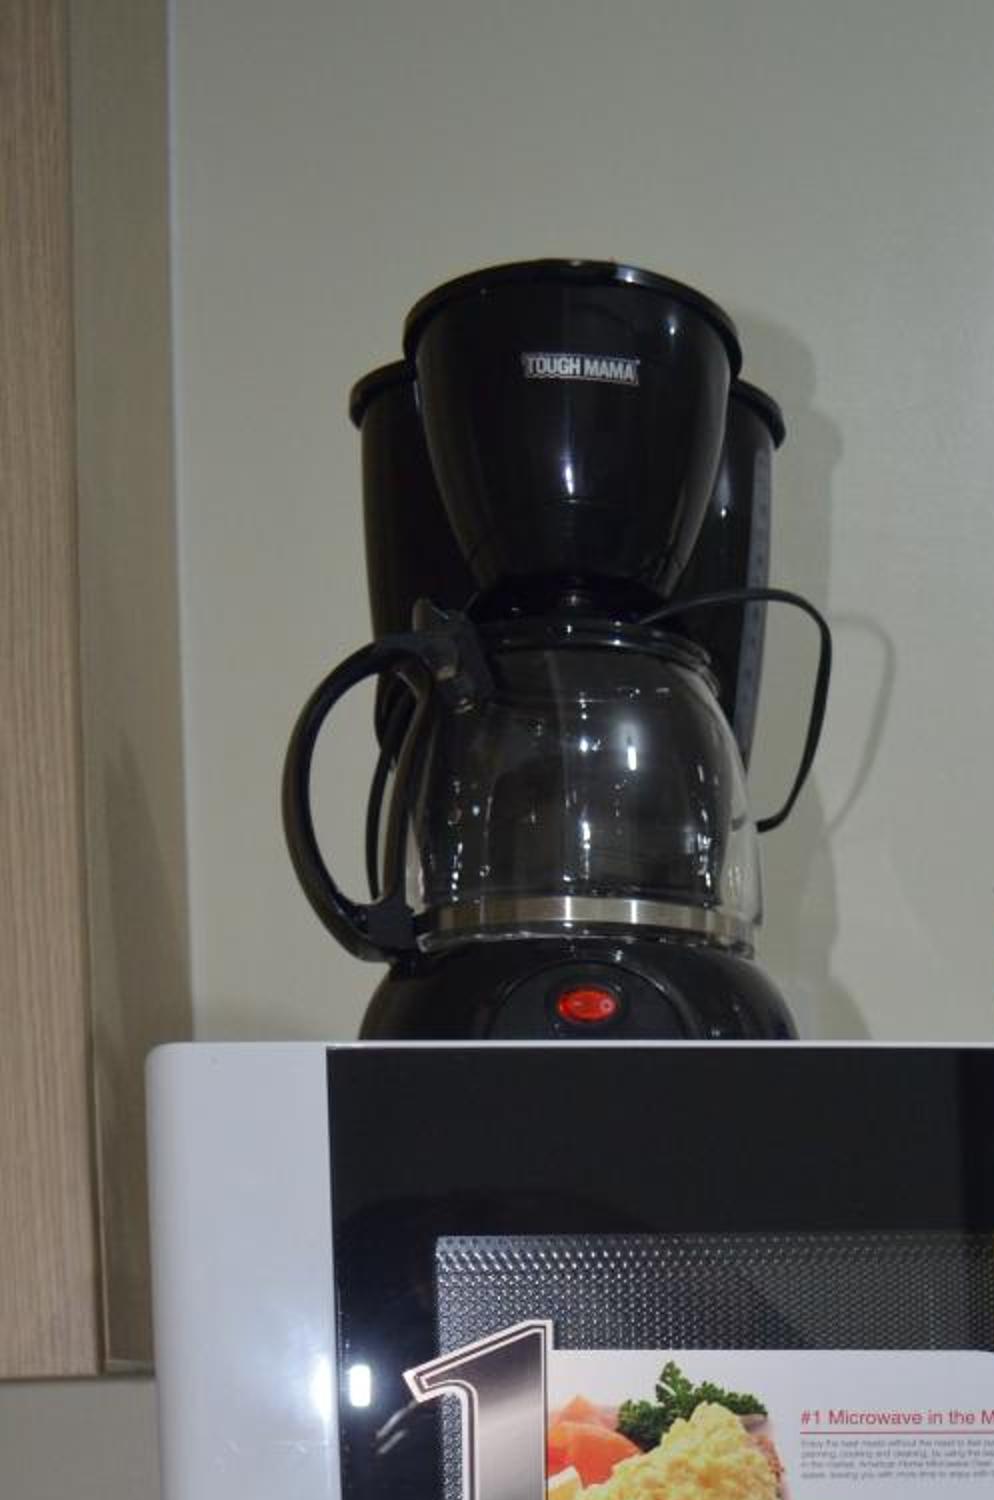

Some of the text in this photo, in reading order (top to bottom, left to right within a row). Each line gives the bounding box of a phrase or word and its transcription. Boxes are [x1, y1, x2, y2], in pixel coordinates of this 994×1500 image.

[527, 357, 634, 382] TOUGH MAMA
[801, 1409, 821, 1426] #1
[828, 1408, 923, 1426] Microwave
[927, 1409, 944, 1425] in
[948, 1409, 976, 1425] the
